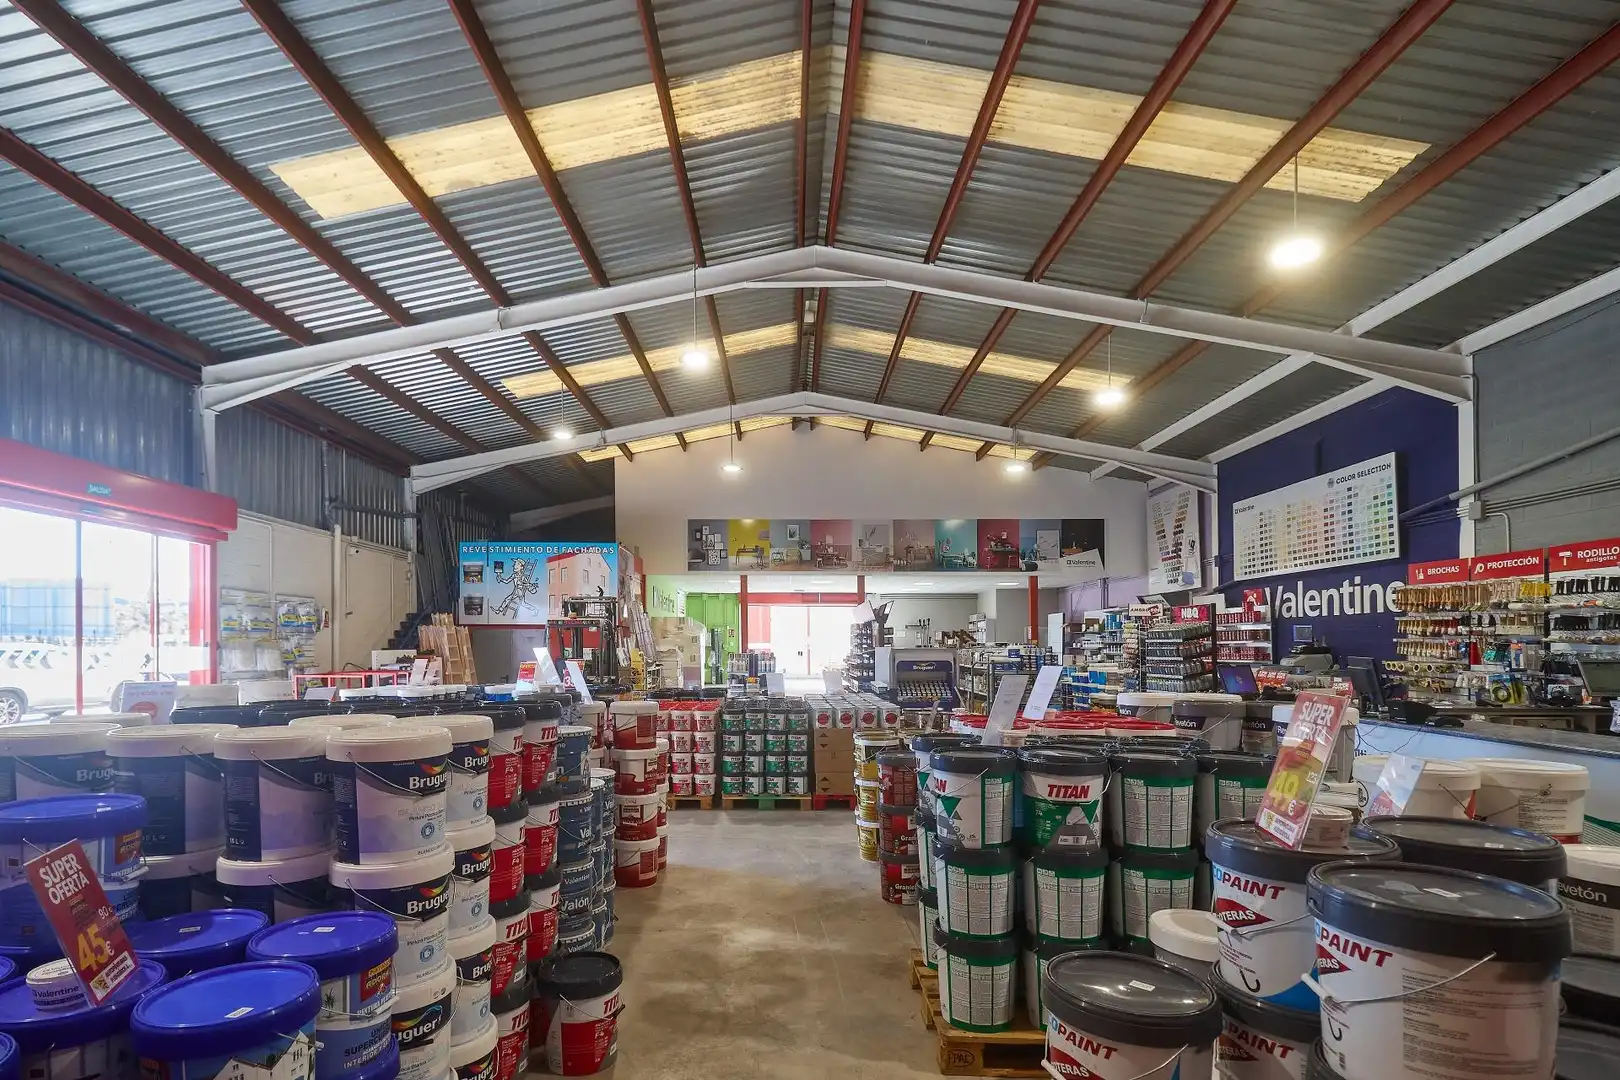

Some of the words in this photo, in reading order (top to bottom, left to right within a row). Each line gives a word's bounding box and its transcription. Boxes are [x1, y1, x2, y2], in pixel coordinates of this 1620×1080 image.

[1335, 473, 1356, 484] COLOR
[1356, 462, 1392, 479] SELECTION
[462, 546, 543, 554] REVESTIMIENTO
[546, 546, 559, 554] DE
[561, 546, 615, 554] FACHADAS
[1577, 546, 1620, 559] RODILLO
[1487, 556, 1540, 570] PROTECCIÓN
[1585, 555, 1617, 563] antigotas
[1427, 565, 1460, 575] BROCHAS
[1300, 696, 1335, 727] SÚPER
[1047, 784, 1091, 798] TITAN
[39, 852, 83, 888] SÚPER
[48, 874, 90, 905] OFERTA
[1556, 881, 1608, 903] evetón
[76, 922, 109, 972] 45
[37, 985, 80, 999] Valentine
